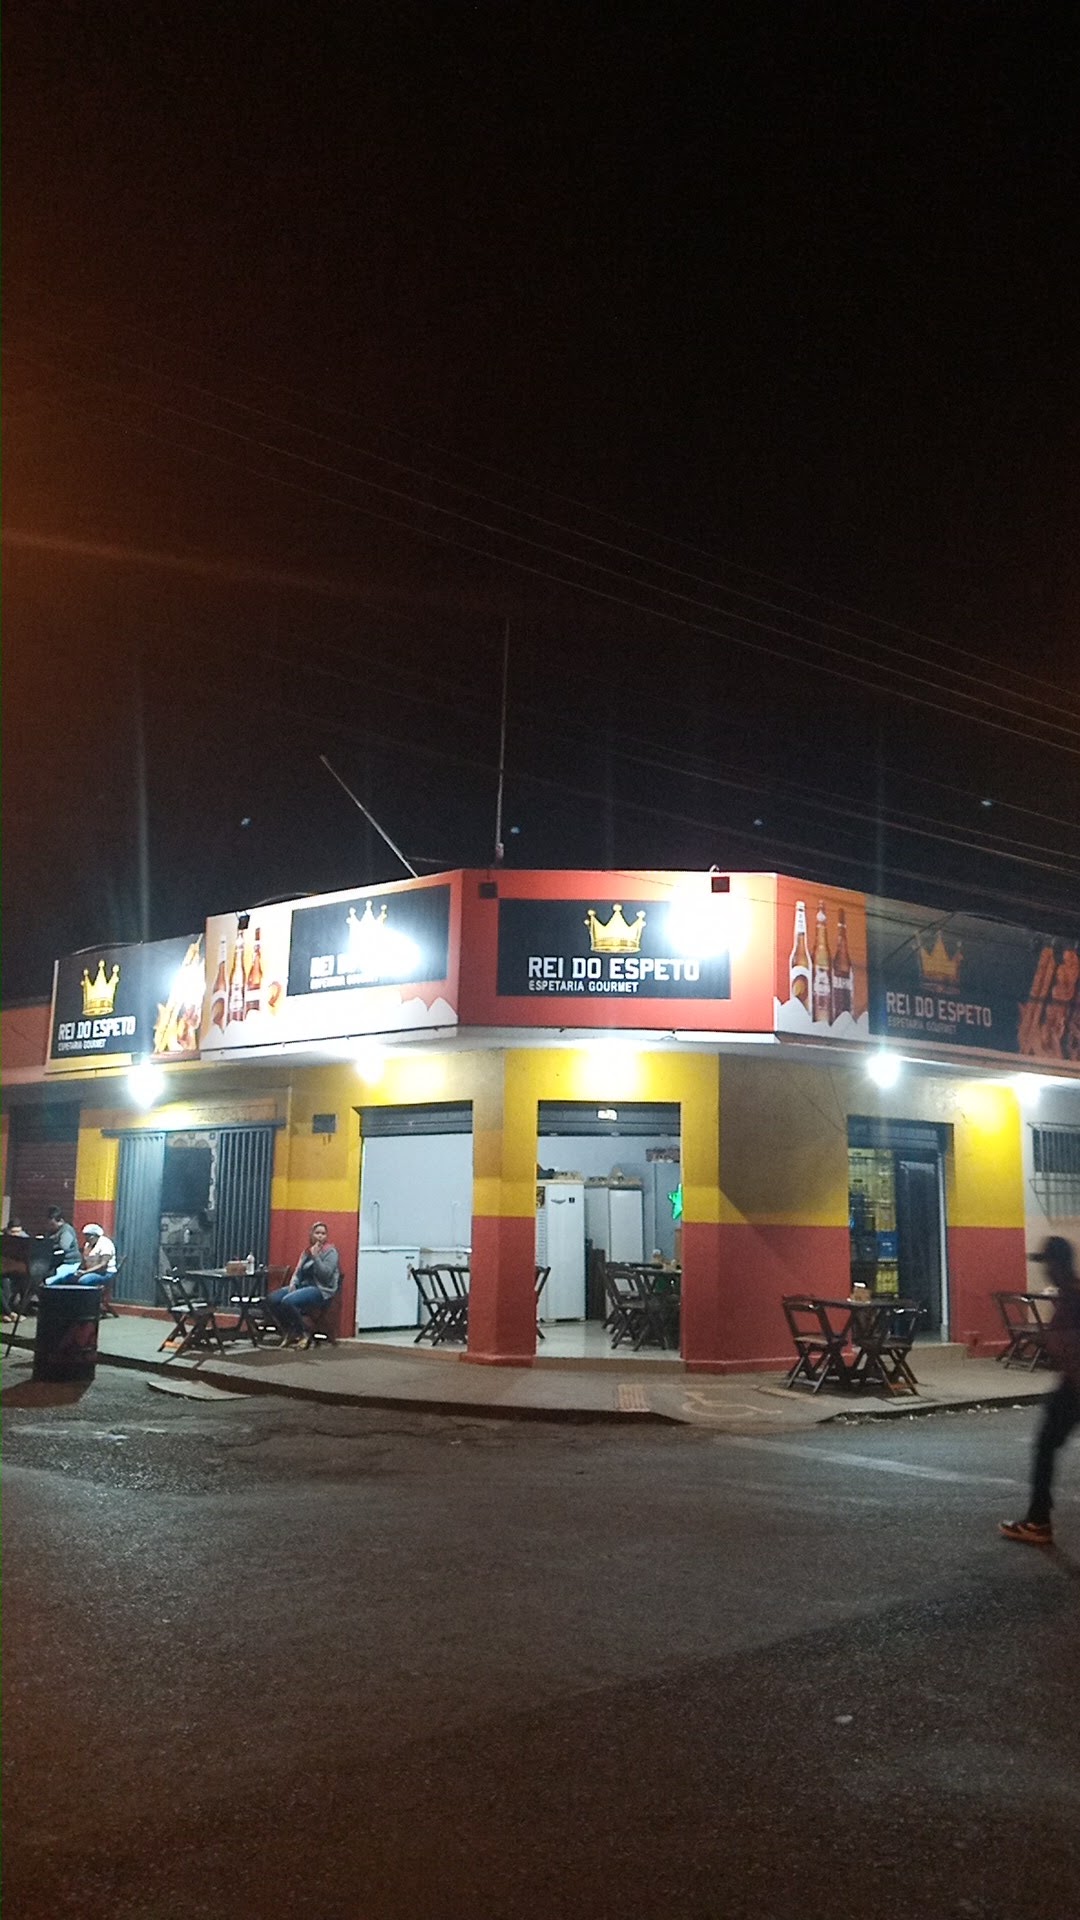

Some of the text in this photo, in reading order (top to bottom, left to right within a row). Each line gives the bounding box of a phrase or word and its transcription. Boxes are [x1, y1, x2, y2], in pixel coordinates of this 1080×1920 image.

[528, 957, 701, 981] REI DO ESPETO
[528, 980, 640, 992] ESPETARIA GOURMET
[886, 992, 993, 1028] REI DO ESPETO
[58, 1016, 136, 1040] REI DO ESPETO
